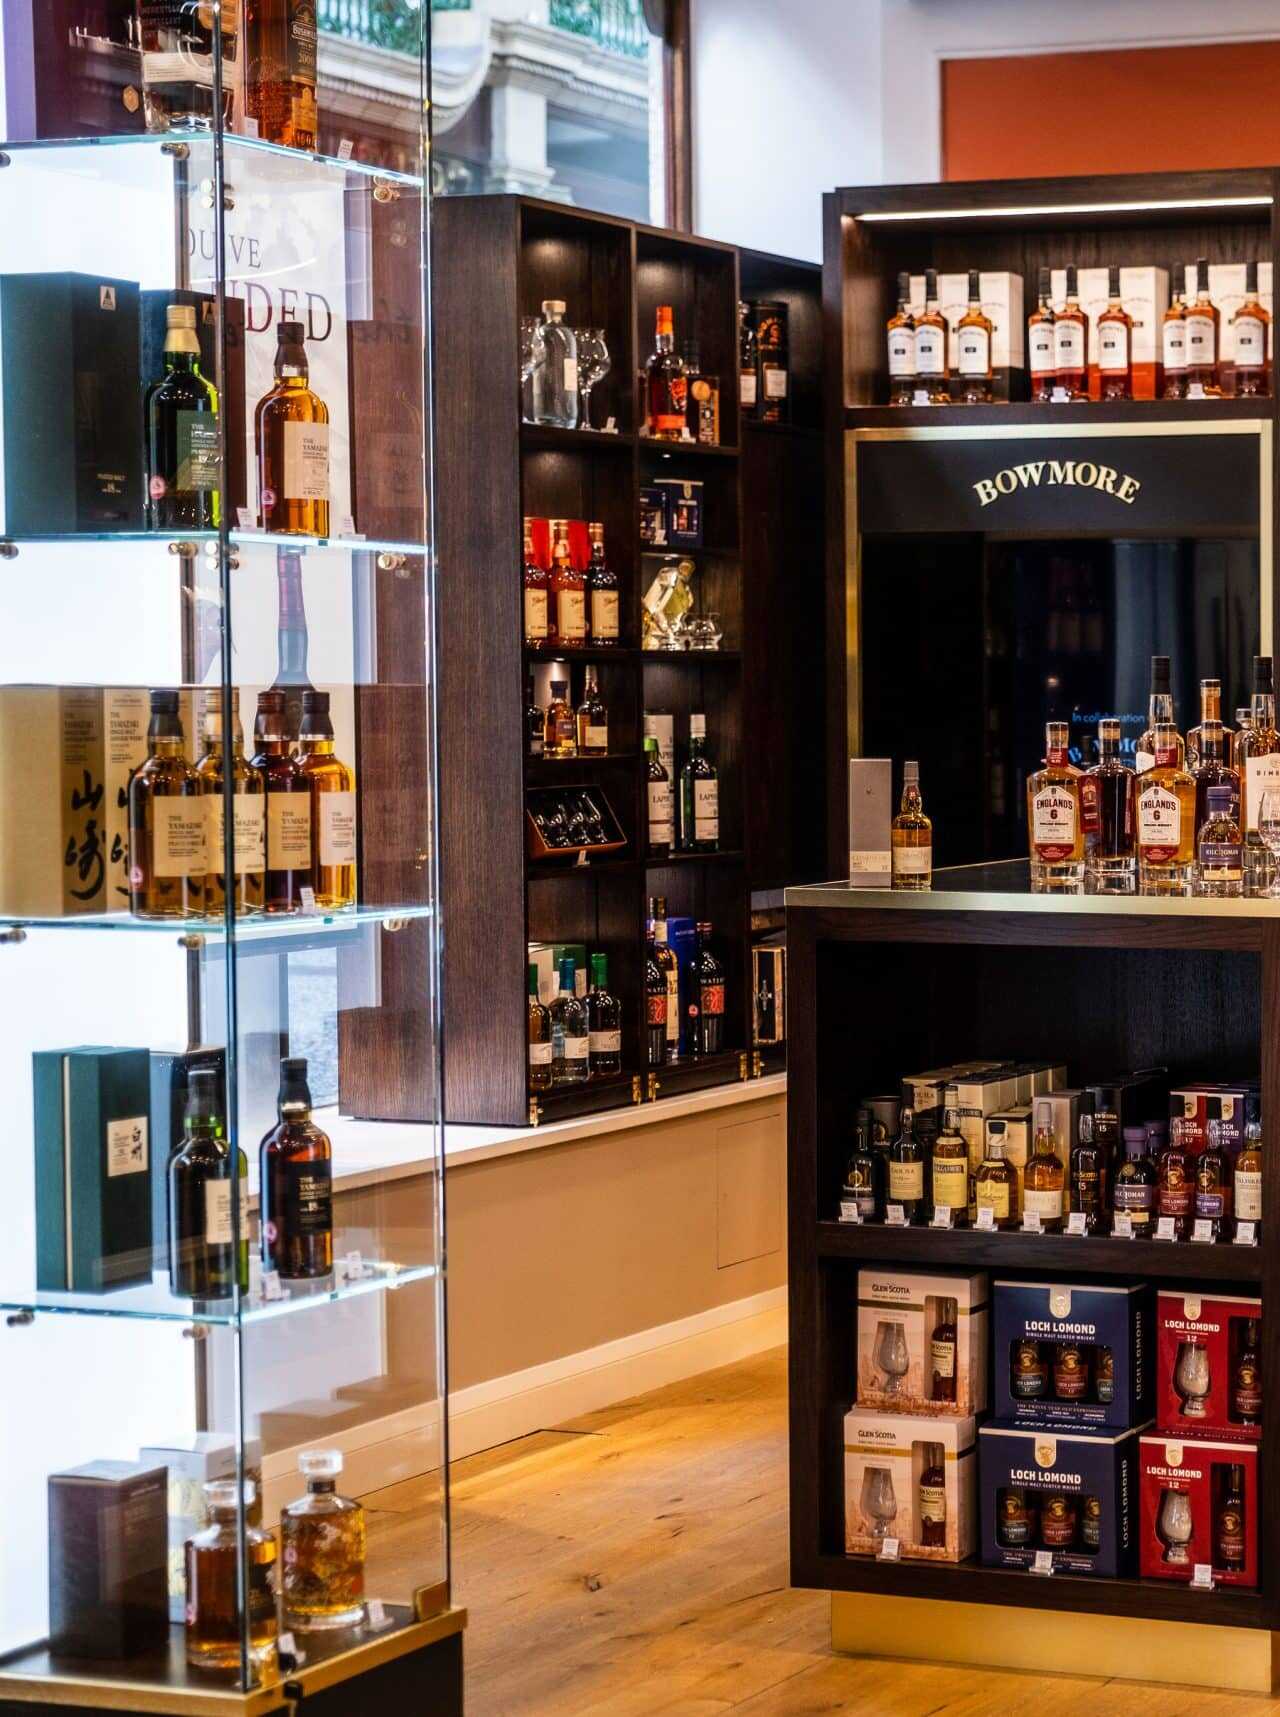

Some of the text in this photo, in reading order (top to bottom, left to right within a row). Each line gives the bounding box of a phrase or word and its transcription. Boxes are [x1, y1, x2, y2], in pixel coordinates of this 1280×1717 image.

[973, 460, 1141, 506] BOWMORE
[1050, 809, 1058, 820] 6
[1153, 810, 1161, 821] 6
[871, 1284, 910, 1294] GLEN SCOTIA
[1025, 1321, 1096, 1335] LOCH LOMOND
[1165, 1320, 1184, 1329] LOCH
[1186, 1321, 1220, 1333] LOMOND
[858, 1430, 896, 1440] GLEN SCOTIA
[1011, 1469, 1081, 1484] LOCH LOMOND
[1146, 1466, 1166, 1476] LOCH
[1168, 1467, 1202, 1479] LOMOND
[1169, 1481, 1179, 1489] 12
